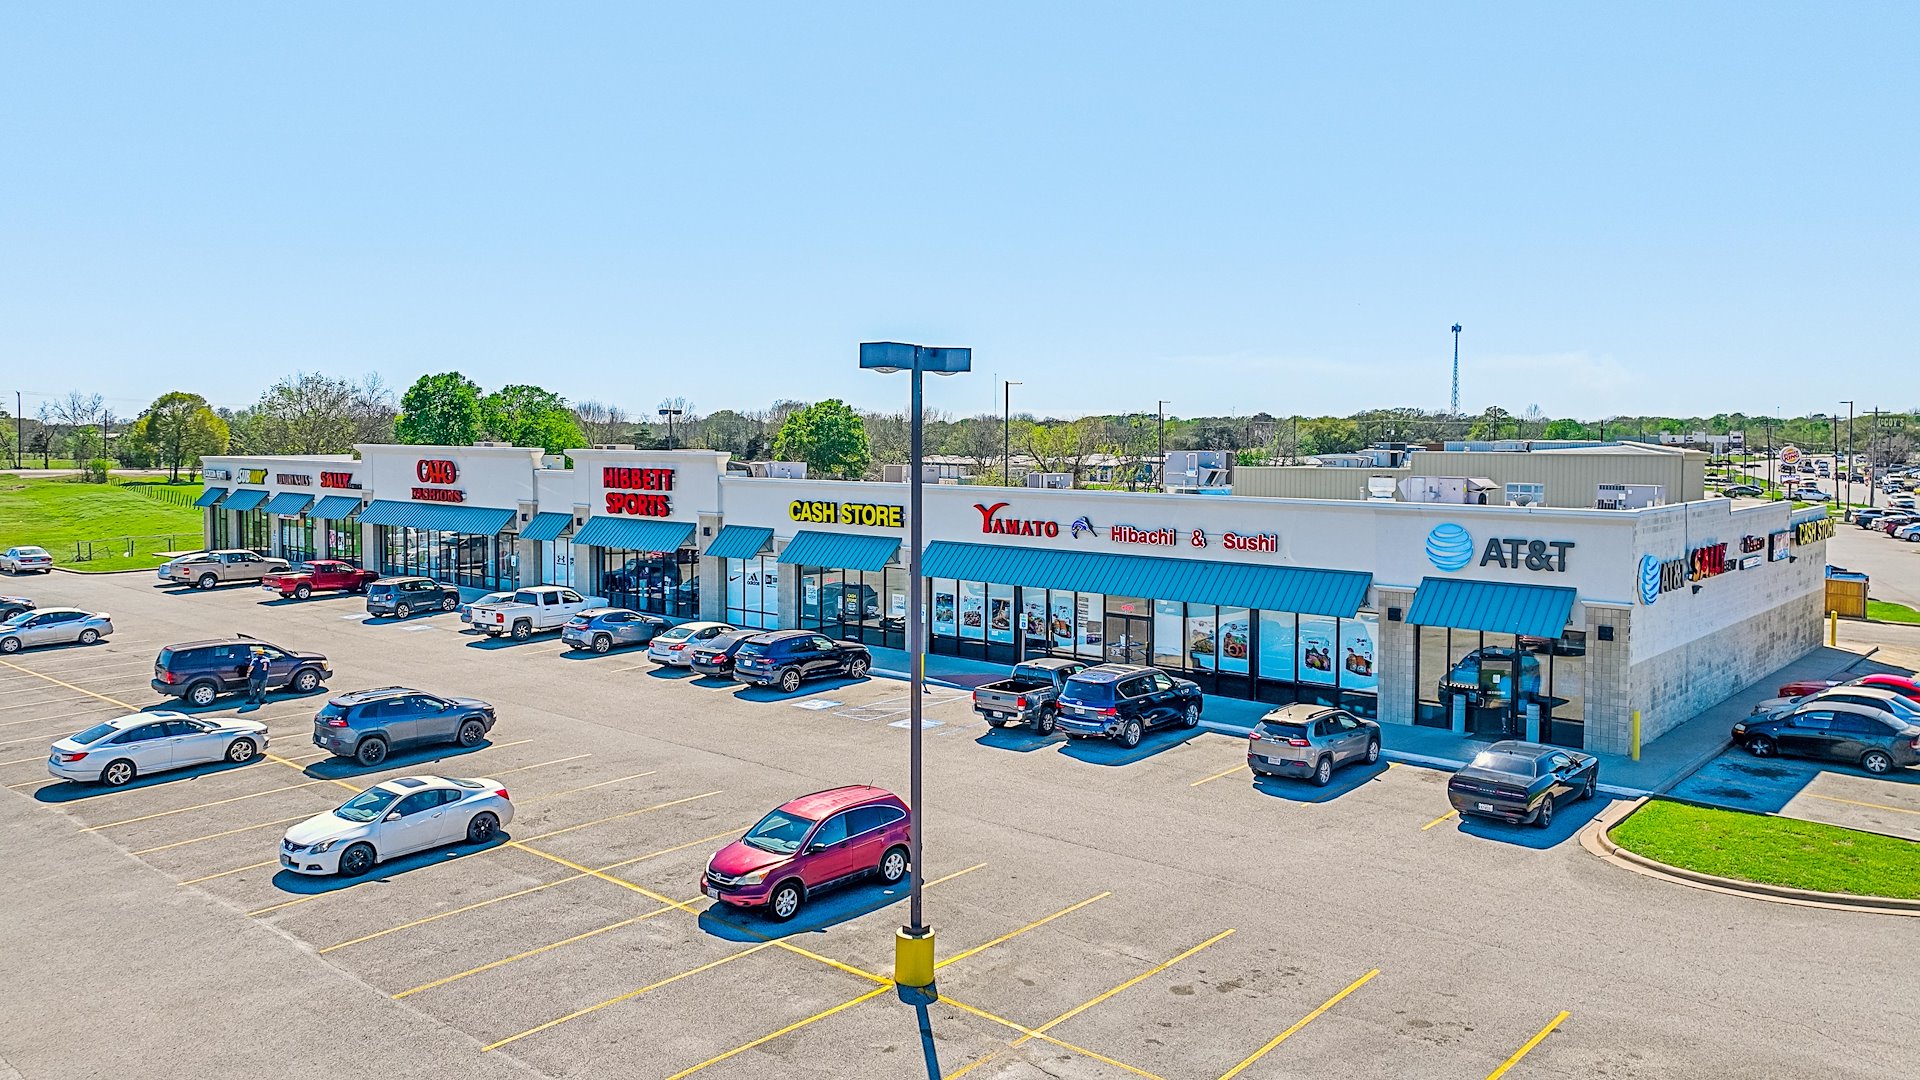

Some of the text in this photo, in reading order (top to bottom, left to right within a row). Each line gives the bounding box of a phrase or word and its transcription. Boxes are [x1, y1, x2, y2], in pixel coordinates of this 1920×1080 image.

[236, 468, 267, 484] SUBWAY
[320, 471, 352, 488] SALLY
[416, 459, 457, 484] CATO
[603, 467, 675, 491] HIBBETT
[411, 487, 464, 503] FASHIONS
[605, 492, 671, 517] SPORTS
[789, 500, 904, 528] CASH STORE
[973, 502, 1059, 538] YAMATO
[1111, 526, 1278, 552] Hibachi & Sushi
[1797, 521, 1817, 545] CASH
[1479, 537, 1576, 572] AT&T
[1690, 542, 1728, 582] SALLY
[1659, 559, 1686, 594] AT&T
